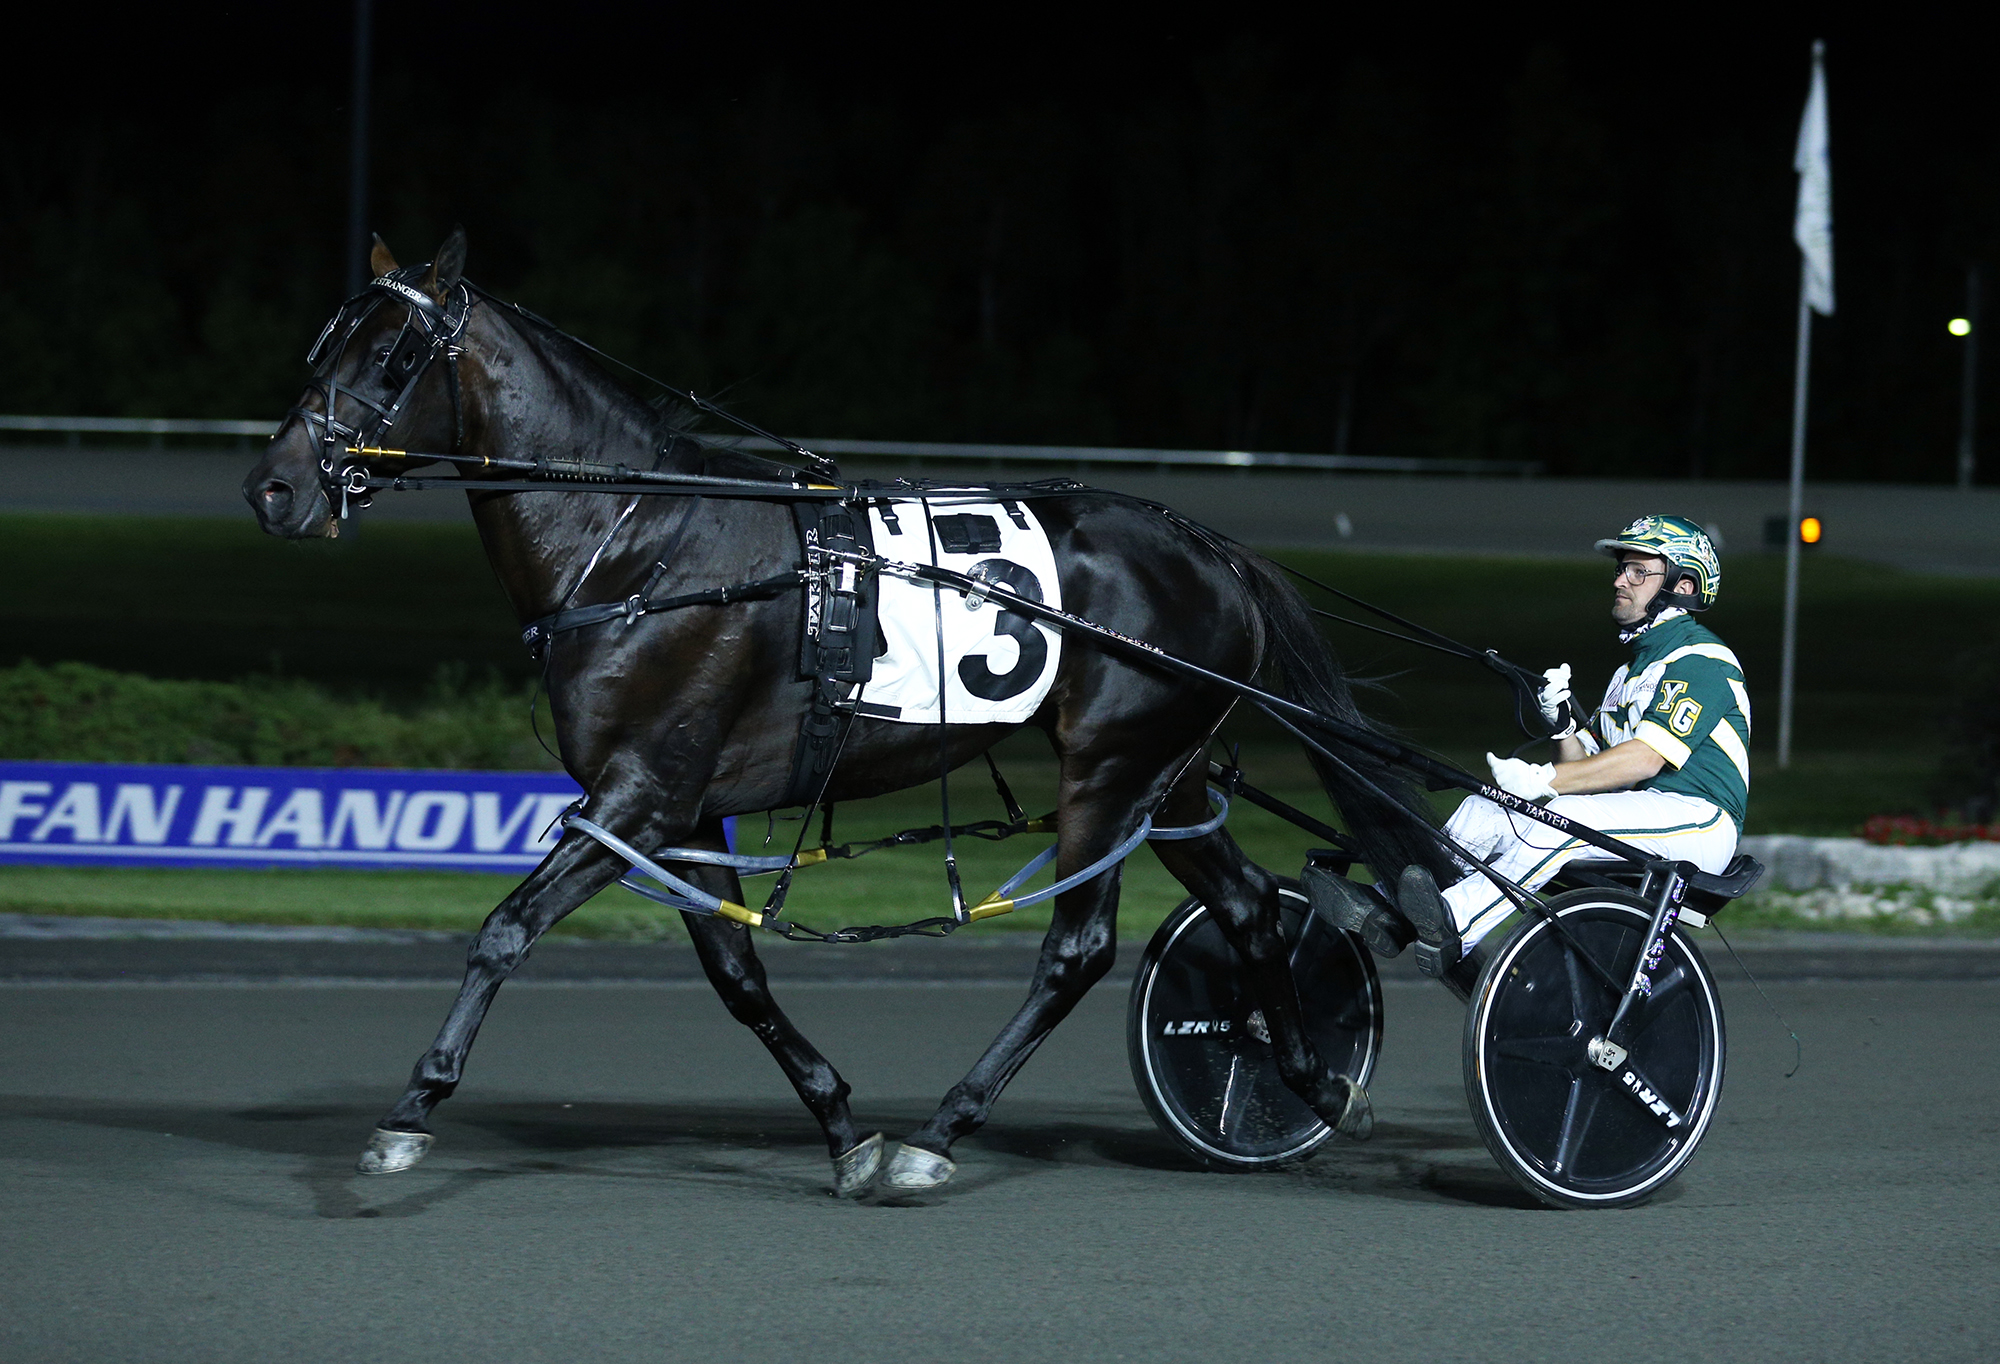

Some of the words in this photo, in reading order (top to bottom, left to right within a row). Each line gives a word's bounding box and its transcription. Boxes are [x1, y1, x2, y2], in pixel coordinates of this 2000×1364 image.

[377, 277, 422, 302] STRANGER
[957, 558, 1048, 702] 3
[0, 780, 182, 844] FAN
[1480, 784, 1523, 809] NANCY
[1524, 801, 1570, 830] TAKTER
